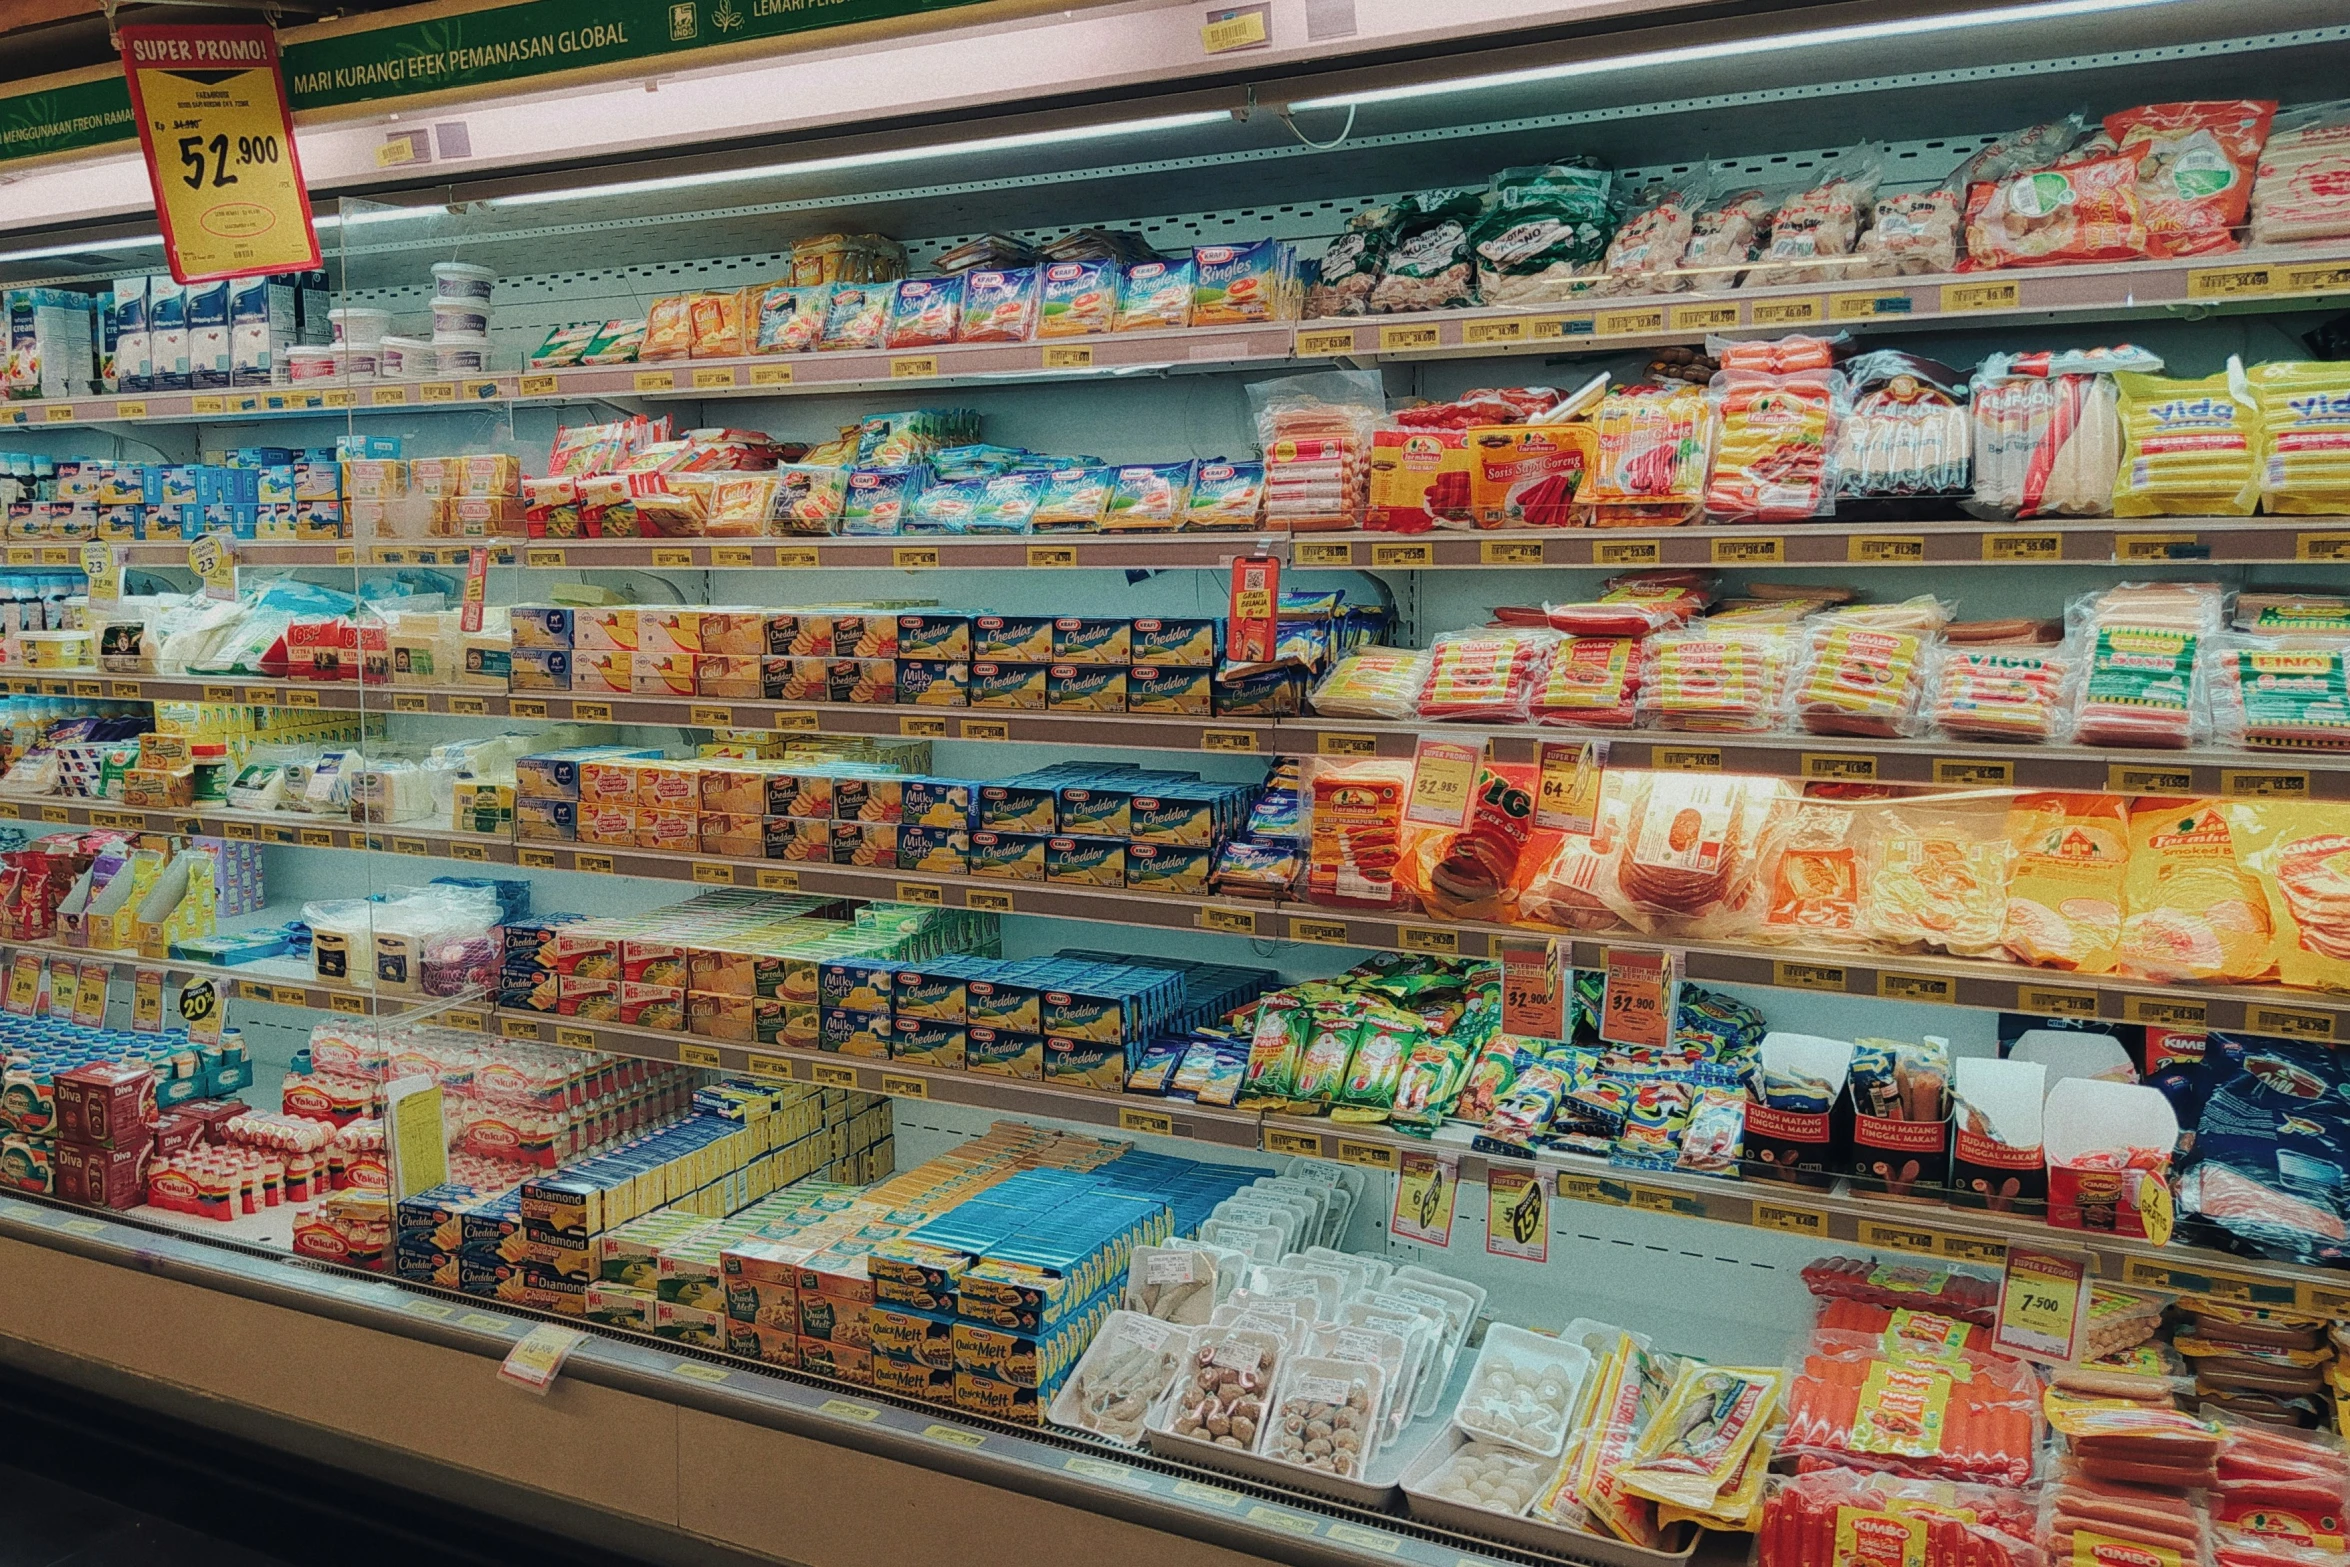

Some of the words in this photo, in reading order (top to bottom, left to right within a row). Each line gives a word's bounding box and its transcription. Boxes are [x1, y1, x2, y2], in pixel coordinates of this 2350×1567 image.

[134, 39, 192, 62] SUPER
[197, 39, 268, 61] PROMO!
[294, 71, 332, 94] MARI
[335, 63, 405, 90] KURANGI
[408, 57, 446, 79] EFEK
[449, 39, 554, 72] PEMANASAN
[558, 22, 628, 55] GLOBAL
[4, 117, 71, 145] MENGGUNAKAN
[73, 111, 103, 135] FREON
[179, 134, 279, 190] 52.900
[1201, 249, 1230, 261] KRAFT
[1052, 267, 1080, 278] KRAFT
[1201, 258, 1251, 285] Singles
[1130, 272, 1180, 297] Singles
[2150, 398, 2236, 422] Vida
[1206, 468, 1229, 477] KRAFT
[1488, 466, 1512, 480] Sosis
[1515, 462, 1541, 477] Sapi
[1543, 453, 1581, 471] Goreng
[853, 476, 875, 486] KRAFT
[1201, 475, 1250, 494] Singles
[853, 485, 898, 505] Singles
[701, 623, 724, 636] Gold
[981, 619, 1000, 627] KRAFT
[1060, 621, 1077, 629] KRAFT
[909, 624, 950, 642] Cheddar
[987, 625, 1033, 643] Cheddar
[1065, 626, 1110, 647] Cheddar
[1145, 627, 1192, 648] Cheddar
[1848, 631, 1900, 648] KIMBO
[1571, 640, 1617, 651] KIMBO
[1677, 643, 1726, 652] KIMBO
[2258, 656, 2324, 669] FINO
[700, 665, 724, 678] Gold
[902, 669, 933, 686] Milky
[905, 681, 929, 693] Soft
[983, 671, 1026, 691] Cheddar
[1060, 674, 1106, 693] Cheddar
[1142, 675, 1190, 695] Cheddar
[1423, 749, 1444, 758] SUPER
[1546, 751, 1569, 761] SUPER
[598, 778, 628, 788] Gurihnya
[657, 783, 688, 793] Gurihnya
[703, 780, 726, 795] Gold
[1418, 779, 1459, 795] 32.985
[905, 789, 934, 806] Milky
[993, 796, 1035, 814] Cheddar
[908, 802, 930, 815] Soft
[1073, 798, 1118, 816] Cheddar
[701, 821, 725, 836] Gold
[902, 836, 933, 852] Milky
[2163, 847, 2218, 856] Smoked
[902, 846, 929, 859] Soft
[559, 937, 574, 952] MEG
[627, 942, 642, 956] MEG
[691, 960, 715, 973] Gold
[1622, 966, 1644, 974] LEBIH
[757, 969, 785, 982] Spready
[825, 973, 854, 988] Milky
[563, 978, 576, 992] MEG
[624, 984, 638, 999] MEG
[826, 985, 850, 997] Soft
[184, 991, 215, 1020] 20%
[1508, 992, 1549, 1008] 32.900
[1612, 995, 1655, 1011] 32.900
[691, 1003, 714, 1017] Gold
[757, 1014, 786, 1028] Spready
[826, 1017, 855, 1033] Milky
[827, 1030, 850, 1041] Soft
[2165, 1037, 2205, 1051] KIMB
[58, 1085, 82, 1105] Diva
[115, 1083, 134, 1097] Diva
[291, 1095, 331, 1111] Yakult
[699, 1097, 730, 1109] Diamond
[1750, 1108, 1780, 1122] SUDAH
[1782, 1112, 1822, 1126] MATANG
[1749, 1117, 1786, 1132] TINGGAL
[1787, 1123, 1821, 1135] MAKAN
[1862, 1119, 1896, 1131] SUDAH
[1898, 1125, 1938, 1137] MATANG
[163, 1134, 182, 1147] Diva
[477, 1129, 512, 1145] Yakult
[1861, 1128, 1901, 1141] TINGGAL
[1903, 1134, 1937, 1144] MAKAN
[1961, 1135, 1995, 1148] SUDAH
[59, 1151, 83, 1169] Diva
[113, 1151, 131, 1163] Diva
[1961, 1144, 2000, 1156] TINGGAL
[2003, 1149, 2039, 1161] MAKAN
[1800, 1163, 1822, 1172] MINI
[356, 1169, 388, 1187] Yakult
[2083, 1180, 2118, 1191] KIMBO
[160, 1180, 195, 1197] Yakult
[535, 1188, 582, 1206] Diamond
[2152, 1188, 2159, 1207] 2
[2142, 1200, 2167, 1231] GRATIS
[306, 1235, 342, 1252] Yakult
[540, 1234, 585, 1250] Diamond
[605, 1239, 618, 1253] MEG
[660, 1258, 675, 1273] MEG
[2013, 1258, 2040, 1271] SUPER
[2042, 1263, 2078, 1279] PROMO!
[538, 1277, 587, 1294] Diamond
[588, 1292, 602, 1305] MEG
[729, 1292, 755, 1304] Quick
[2021, 1293, 2058, 1313] 7.500
[735, 1301, 756, 1312] Melt
[804, 1311, 831, 1322] Quick
[811, 1318, 830, 1329] Melt
[1854, 1519, 1910, 1539] KIMBO
[2094, 1547, 2161, 1567] KIMBO
